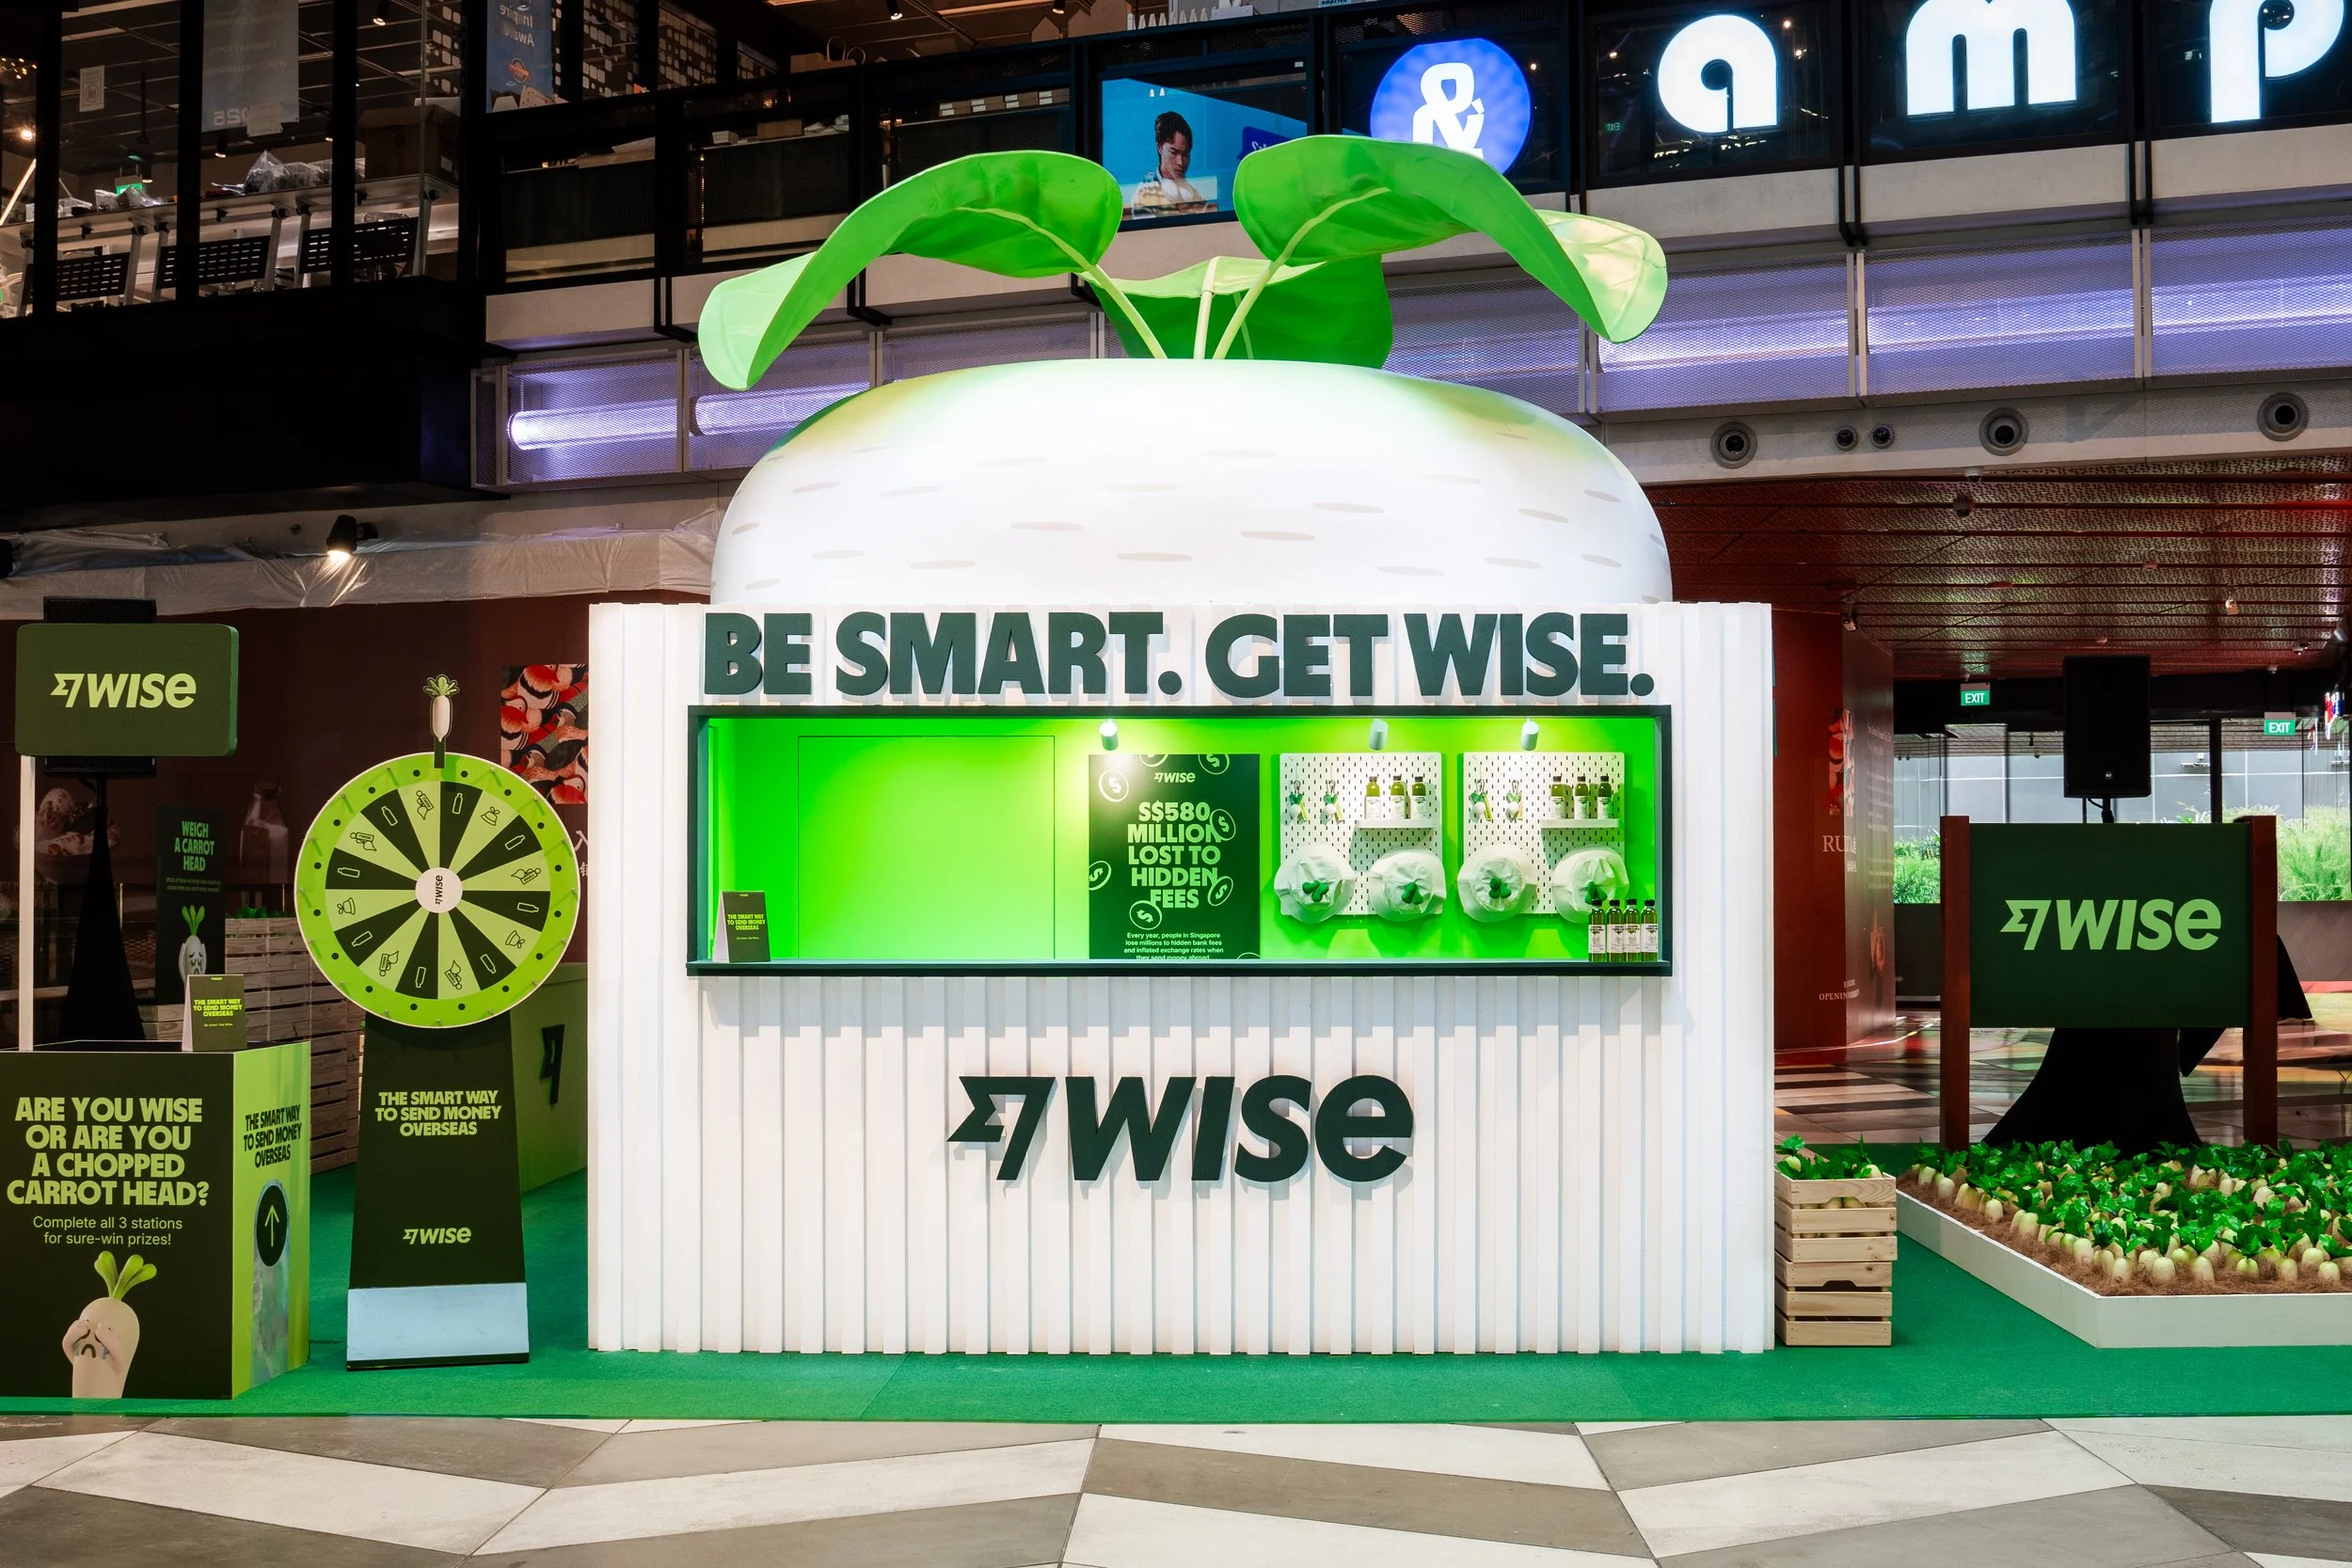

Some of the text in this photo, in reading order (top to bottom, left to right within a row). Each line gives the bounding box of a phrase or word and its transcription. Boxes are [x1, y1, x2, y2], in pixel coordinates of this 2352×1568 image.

[705, 611, 1654, 698] BE SMART. GET WISE.
[1964, 693, 1985, 705] EXIT
[2268, 722, 2292, 734] EXIT
[1138, 800, 1211, 823] S$580
[182, 821, 209, 838] WEIGH
[1127, 824, 1221, 843] MILLION
[174, 837, 215, 855] A CARROT
[1128, 846, 1220, 864] LOST TO
[183, 855, 206, 871] HEAD
[1132, 867, 1219, 887] HIDDEN
[1150, 889, 1200, 909] FEES
[1190, 932, 1220, 941] Singapore
[378, 1090, 499, 1106] THE SMART WAY
[15, 1097, 202, 1123] ARE YOU WISE
[246, 1104, 301, 1132] THE SMART WAY
[374, 1106, 501, 1121] TO SEND MONEY
[25, 1125, 191, 1150] OR ARE YOU
[244, 1123, 302, 1151] TO SEND MONEY
[400, 1122, 478, 1136] OVERSEAS
[31, 1152, 185, 1178] A CHOPPED
[255, 1144, 291, 1168] OVERSEAS
[7, 1180, 210, 1207] CARROT HEAD?
[33, 1215, 183, 1230] Complete all 3 stations
[43, 1231, 171, 1247] for sure-win prizes!
